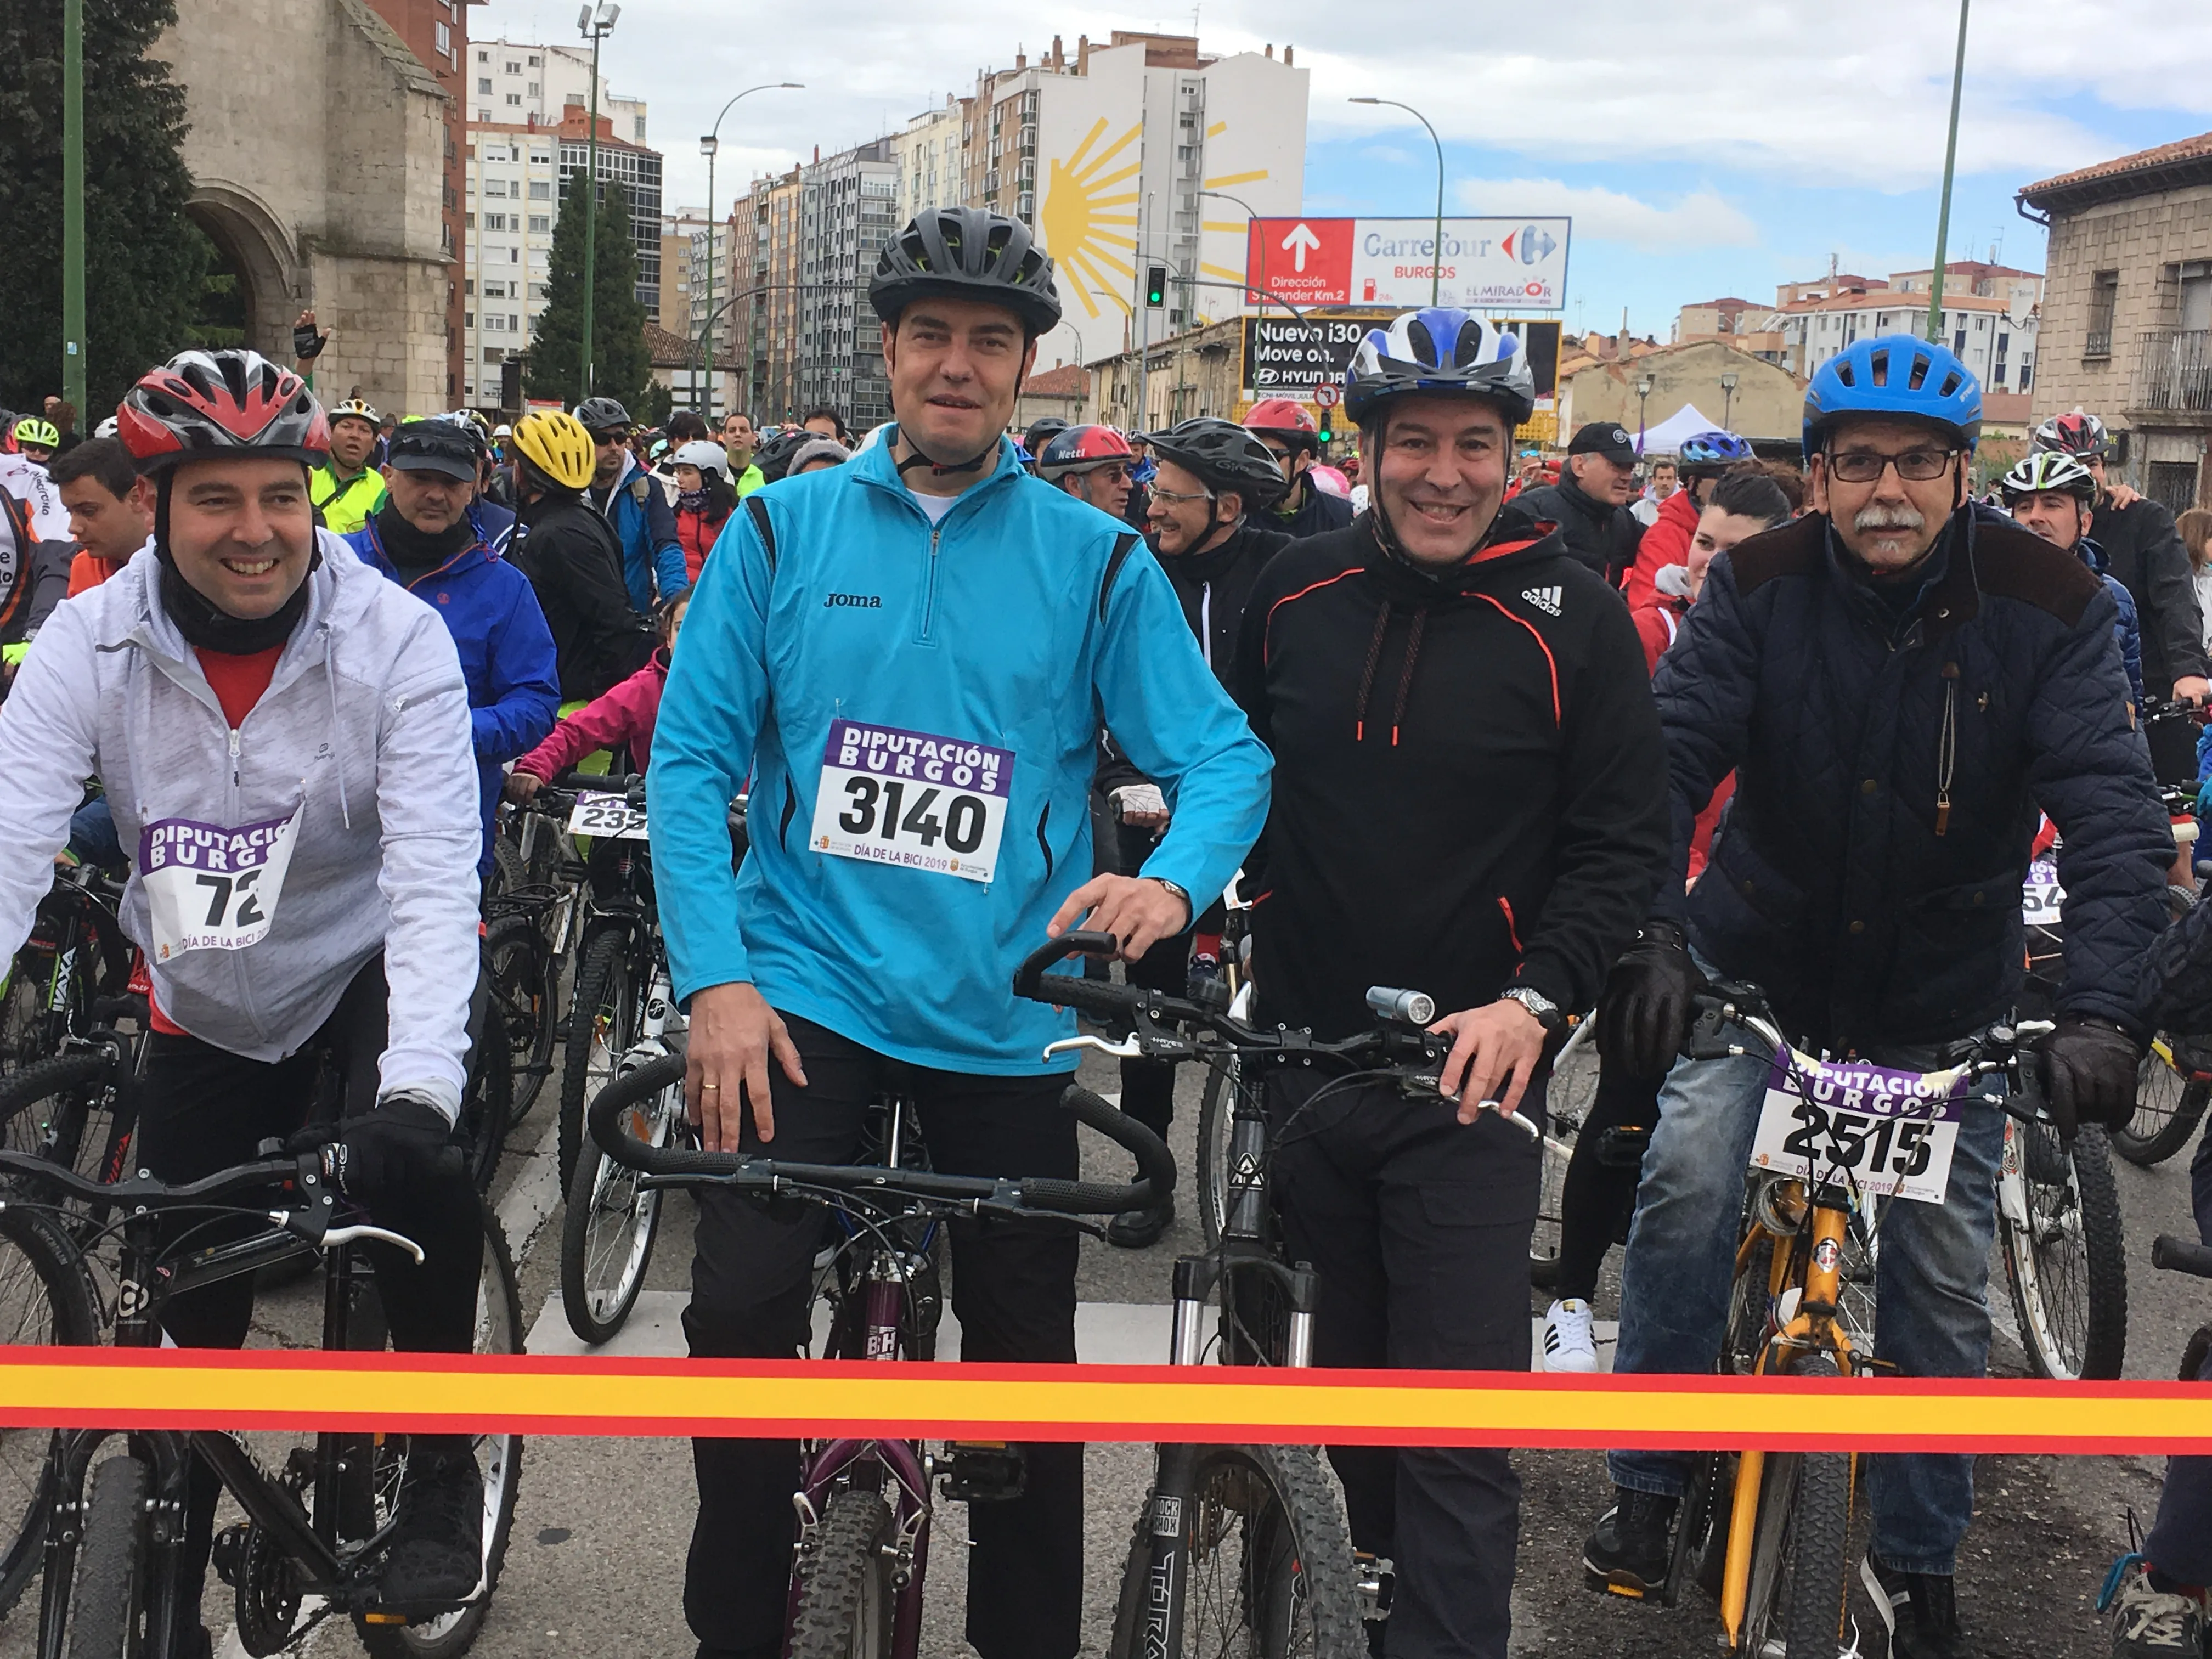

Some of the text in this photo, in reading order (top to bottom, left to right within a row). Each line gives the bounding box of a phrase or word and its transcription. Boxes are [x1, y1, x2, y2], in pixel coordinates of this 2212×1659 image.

[1364, 232, 1492, 258] Carrefour
[1271, 276, 1326, 288] Dirección
[1394, 266, 1456, 279] BURGOS
[1314, 291, 1345, 301] Km.2
[1481, 282, 1552, 297] MIRADOR
[1255, 322, 1362, 343] Nuevo i30
[1254, 345, 1302, 362] Move
[1521, 590, 1562, 617] adidas
[843, 727, 1000, 772] DIPUTACIÓN
[839, 745, 998, 792] BURGOS
[582, 808, 648, 831] 235
[839, 775, 987, 854] 3140
[151, 820, 290, 853] DIPUTACIÓ
[150, 843, 269, 870] BURG
[854, 843, 871, 857] DÍA
[873, 848, 886, 860] DE
[889, 850, 901, 863] LA
[904, 853, 922, 866] BICI
[924, 857, 947, 871] 2019
[195, 868, 266, 928] 72
[182, 935, 199, 949] DÍA
[202, 935, 217, 946] DE
[220, 936, 233, 948] LA
[236, 932, 255, 946] BICI
[1782, 1103, 1935, 1177] 2515
[1832, 1173, 1845, 1185] LA
[1869, 1181, 1893, 1193] 2019
[867, 1331, 896, 1355] BH
